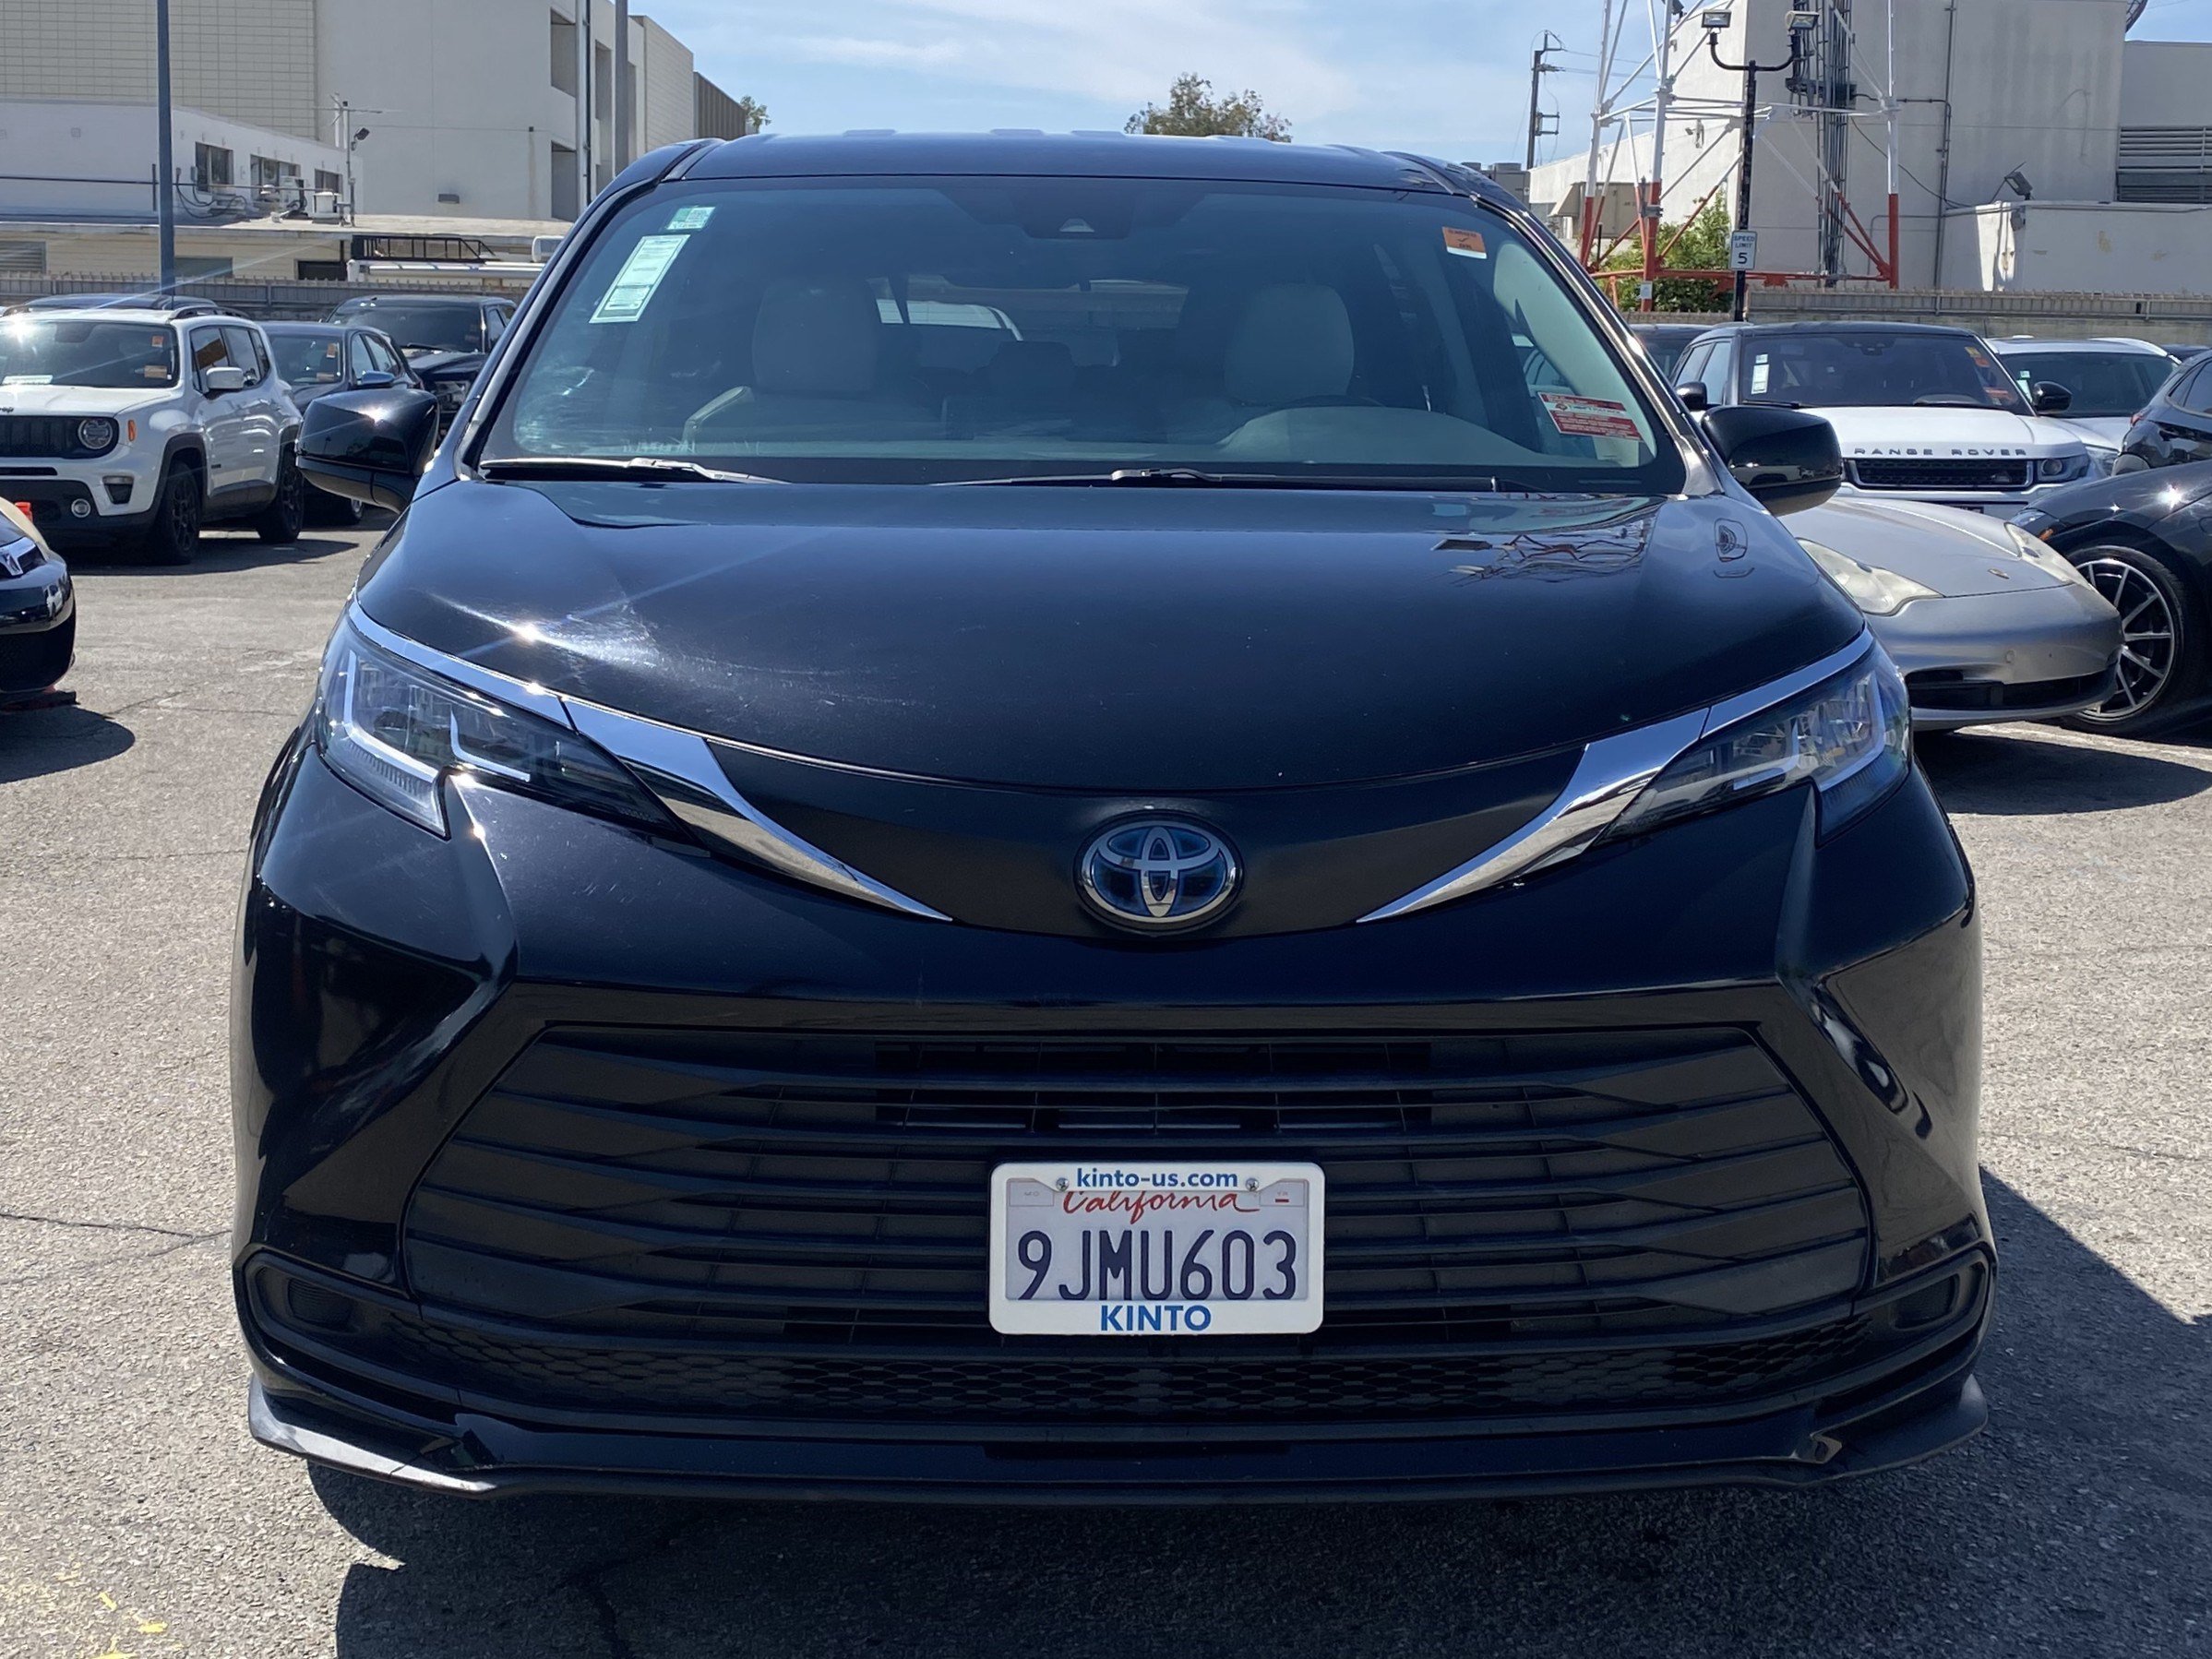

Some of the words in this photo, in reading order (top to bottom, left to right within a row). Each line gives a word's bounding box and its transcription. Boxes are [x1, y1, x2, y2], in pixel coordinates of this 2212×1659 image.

[1738, 252, 1748, 265] 5
[1854, 448, 1933, 456] RANGE
[1076, 1168, 1238, 1188] kinto-us.com
[1063, 1190, 1261, 1225] California
[1017, 1229, 1297, 1301] 9JMU603
[1100, 1305, 1213, 1331] KINTO
